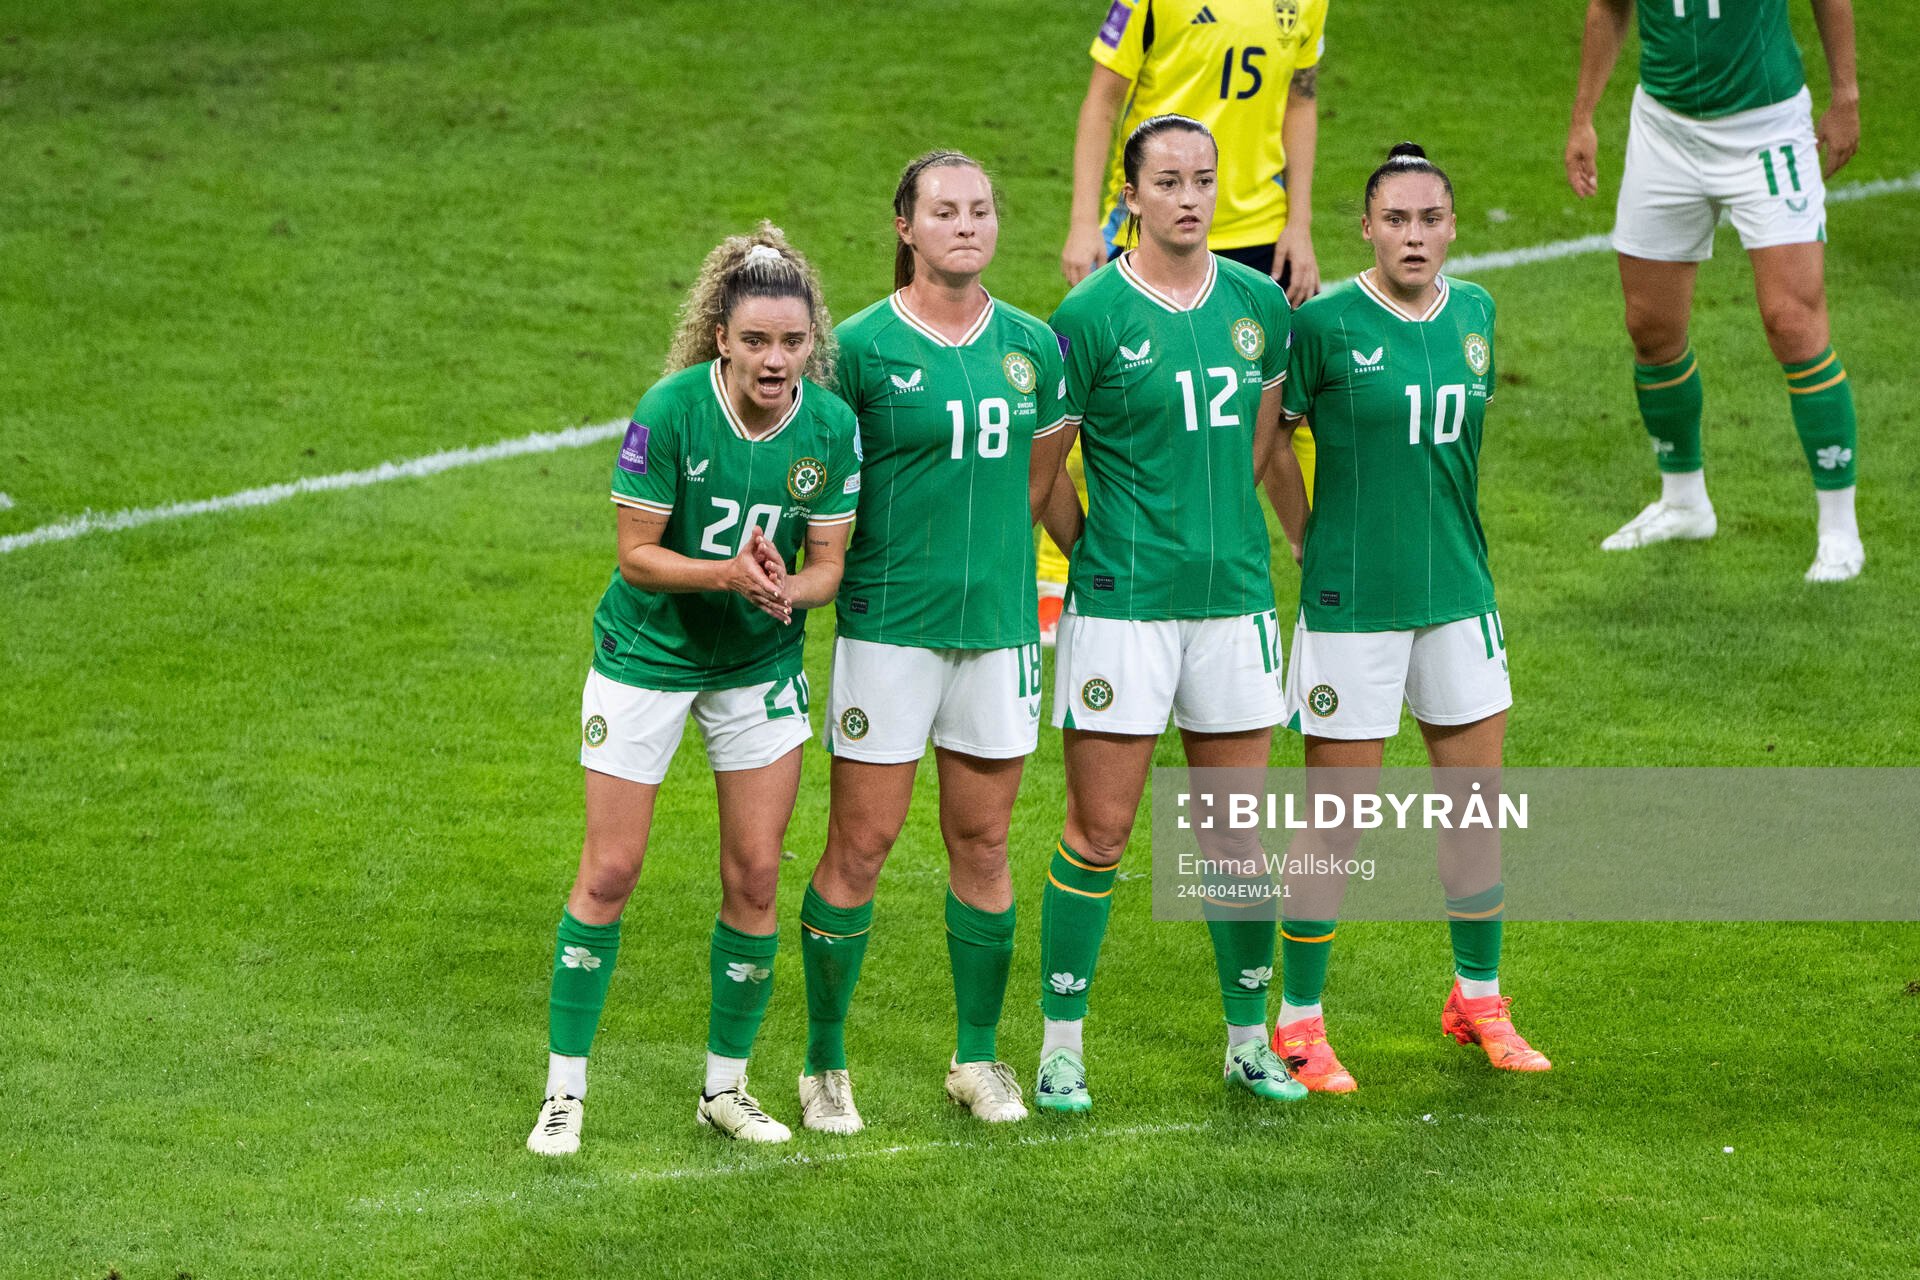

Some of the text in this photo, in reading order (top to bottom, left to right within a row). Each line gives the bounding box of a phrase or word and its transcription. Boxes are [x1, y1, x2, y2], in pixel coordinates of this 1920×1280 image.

[1220, 46, 1266, 99] 15
[1758, 144, 1801, 196] 11
[1124, 358, 1153, 369] CASTORE
[1354, 365, 1385, 374] CASTORE
[895, 385, 925, 395] CASTORE
[1175, 366, 1240, 431] 12
[1405, 384, 1466, 445] 10
[946, 397, 1010, 460] 18
[793, 460, 824, 476] IRELAND
[701, 496, 783, 556] 20
